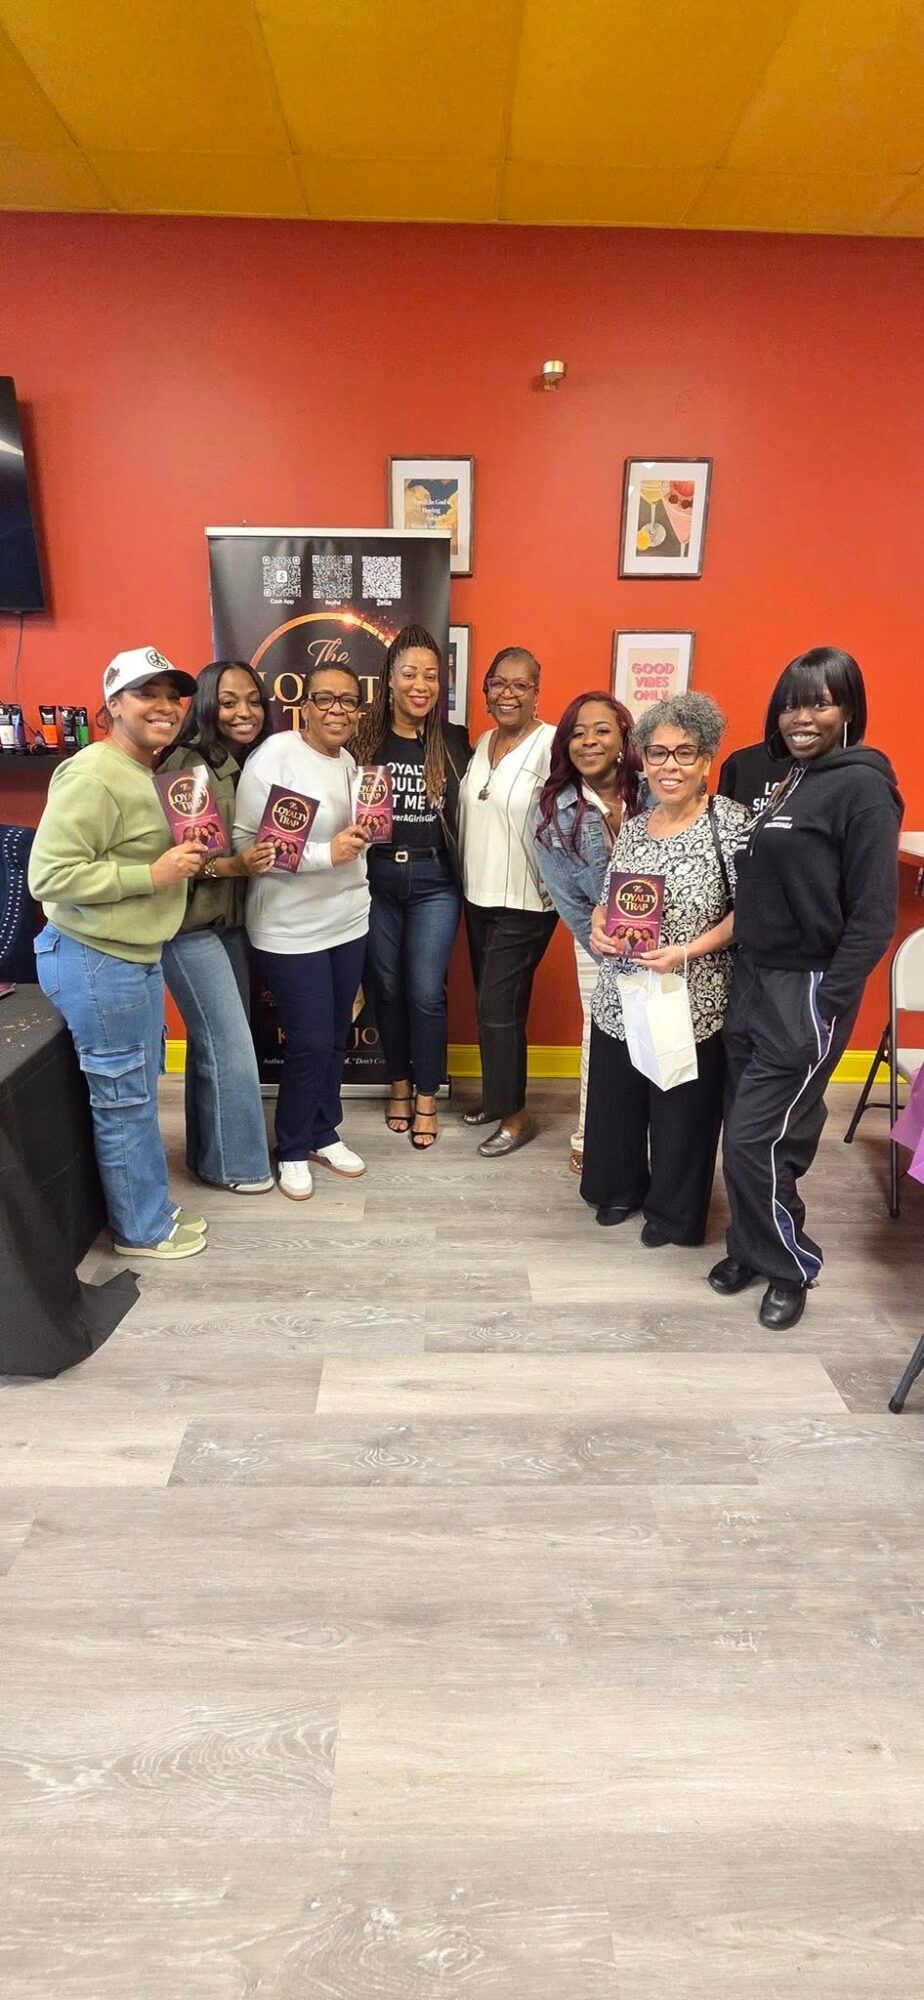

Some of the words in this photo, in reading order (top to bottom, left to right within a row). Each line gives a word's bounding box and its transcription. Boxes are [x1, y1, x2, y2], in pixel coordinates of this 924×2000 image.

[307, 637, 351, 667] The
[631, 662, 675, 675] GOOD
[635, 676, 670, 688] VIBES
[633, 690, 669, 701] ONLY
[360, 784, 387, 793] OYALTY
[404, 795, 426, 810] ME
[275, 805, 307, 823] LOYALTY
[279, 814, 300, 828] TRAP
[619, 892, 657, 903] LOYALTY
[624, 900, 649, 912] TRAP
